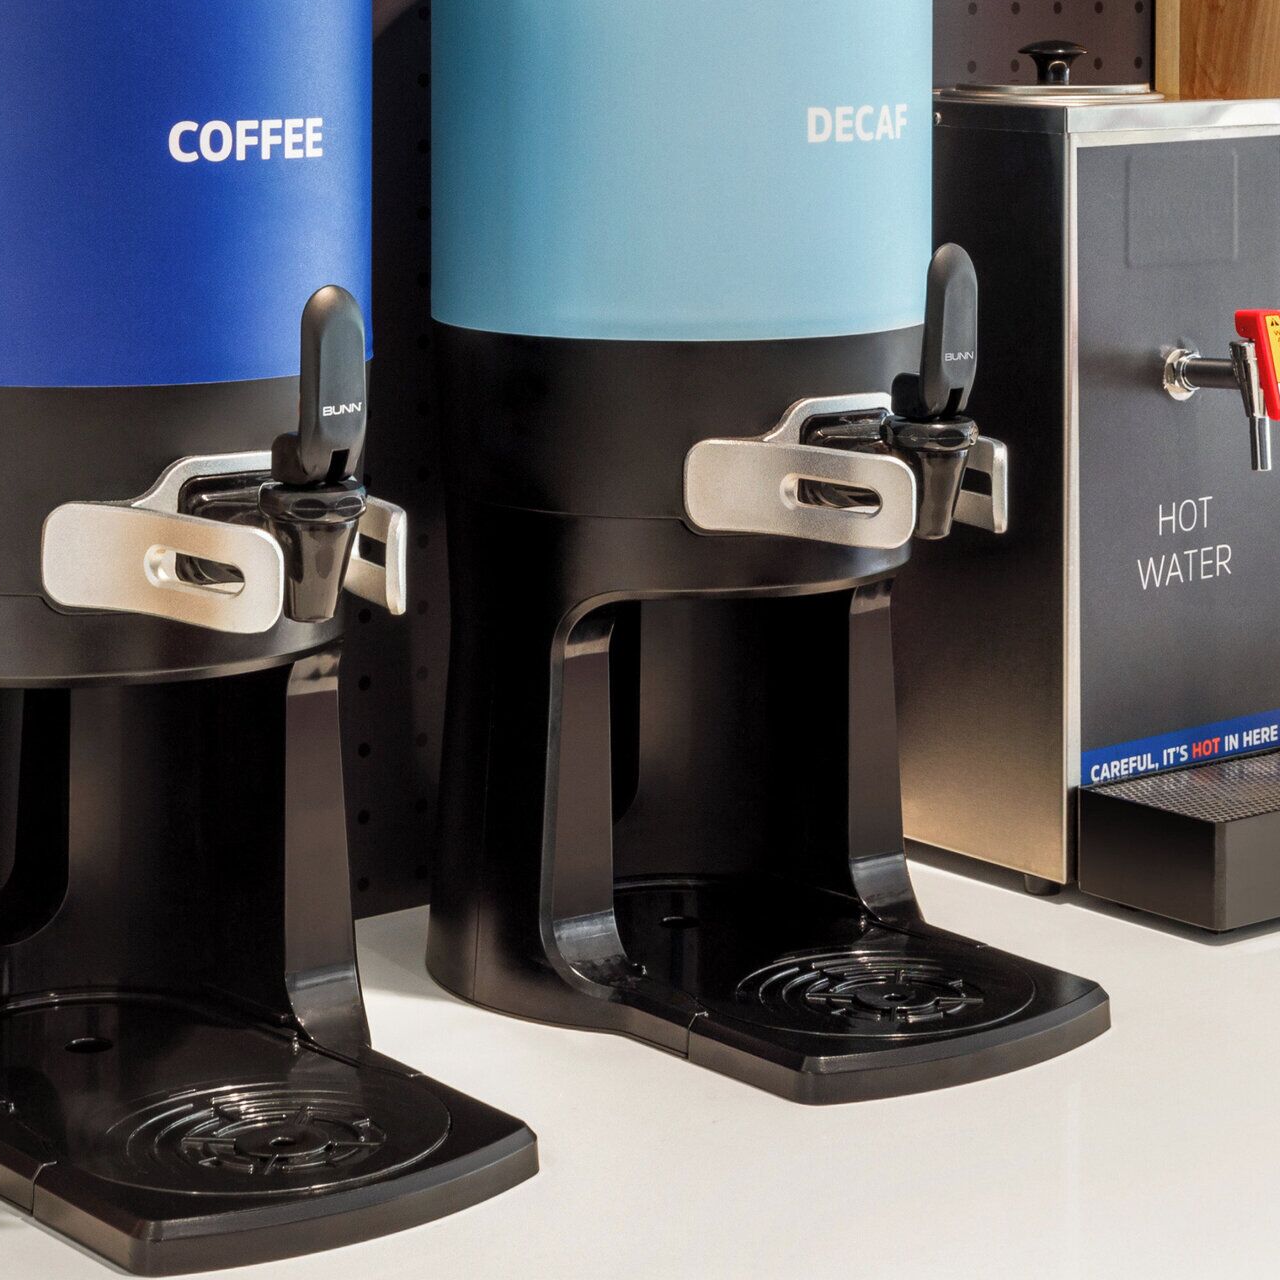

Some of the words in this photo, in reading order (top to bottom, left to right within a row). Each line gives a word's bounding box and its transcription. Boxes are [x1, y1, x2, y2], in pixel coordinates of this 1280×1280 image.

[168, 118, 323, 163] COFFEE
[807, 104, 908, 143] DECAF
[944, 351, 974, 362] BUNN
[322, 402, 362, 417] BUNN
[1158, 496, 1213, 536] HOT
[1137, 544, 1232, 590] WATER
[1090, 753, 1160, 782] CAREFUL,
[1162, 745, 1188, 766] IT'S
[1192, 737, 1221, 759] HOT
[1224, 733, 1239, 752] IN
[1242, 724, 1279, 748] HERE
